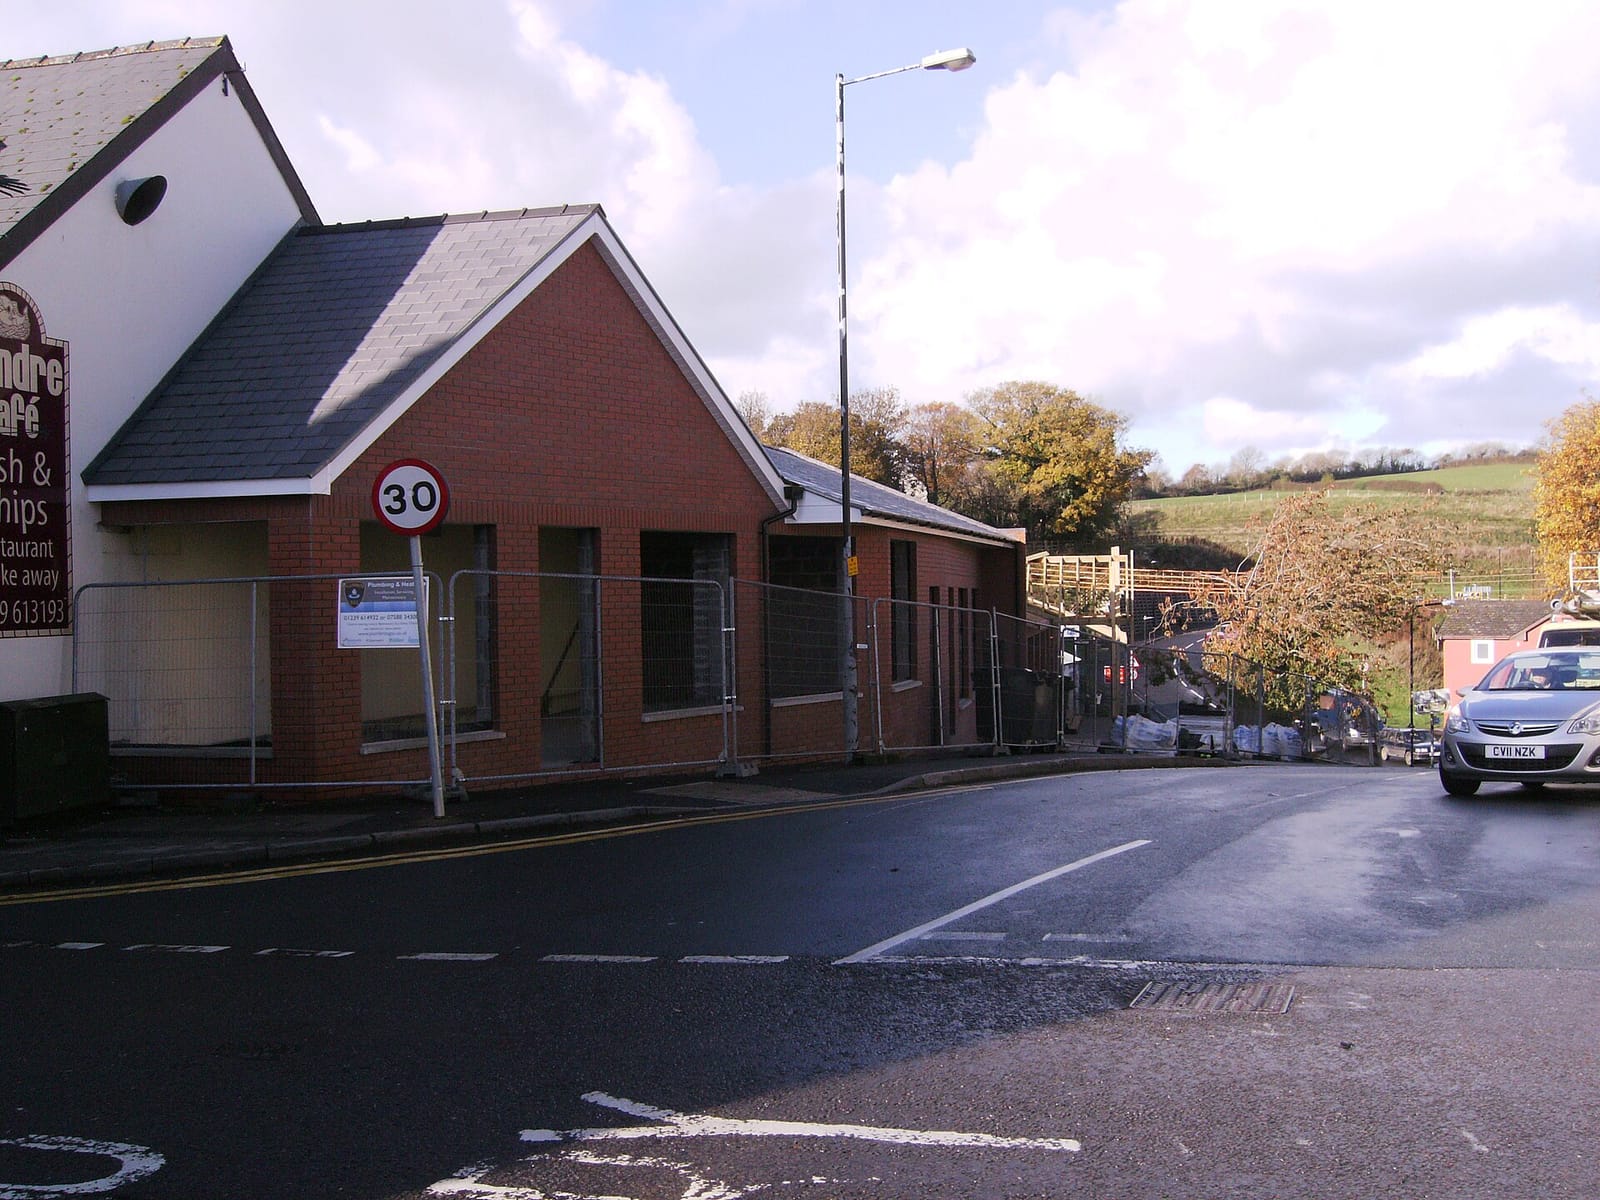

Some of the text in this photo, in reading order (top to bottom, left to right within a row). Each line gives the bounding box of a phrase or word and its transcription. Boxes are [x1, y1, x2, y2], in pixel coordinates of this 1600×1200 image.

[33, 451, 51, 487] &
[383, 481, 437, 515] 30
[22, 569, 59, 592] away
[12, 599, 64, 624] 613193
[1515, 746, 1536, 757] NZK
